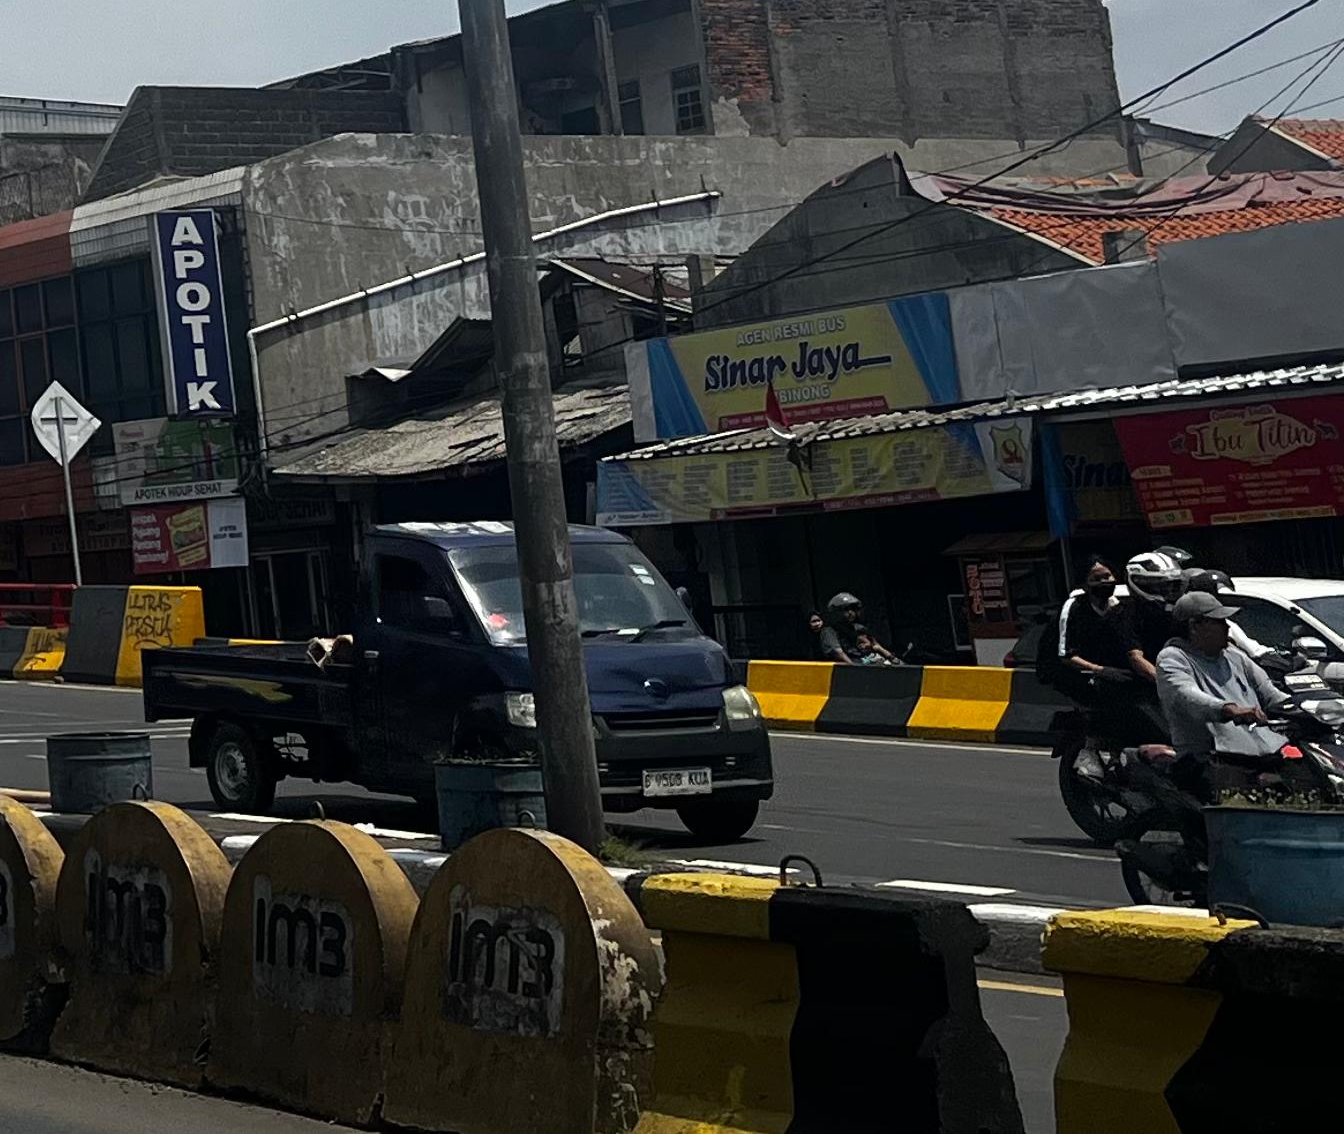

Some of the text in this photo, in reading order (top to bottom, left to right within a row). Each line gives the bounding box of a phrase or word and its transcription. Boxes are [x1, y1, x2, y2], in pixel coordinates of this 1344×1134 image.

[170, 216, 222, 411] APOTIK
[736, 316, 846, 347] AGEN RESMI BUS
[705, 342, 890, 391] Sinar Jaya
[774, 384, 832, 403] BINONG
[1197, 417, 1314, 458] Ibu Titin
[134, 482, 222, 500] APOTEK HIDUP SEHAT
